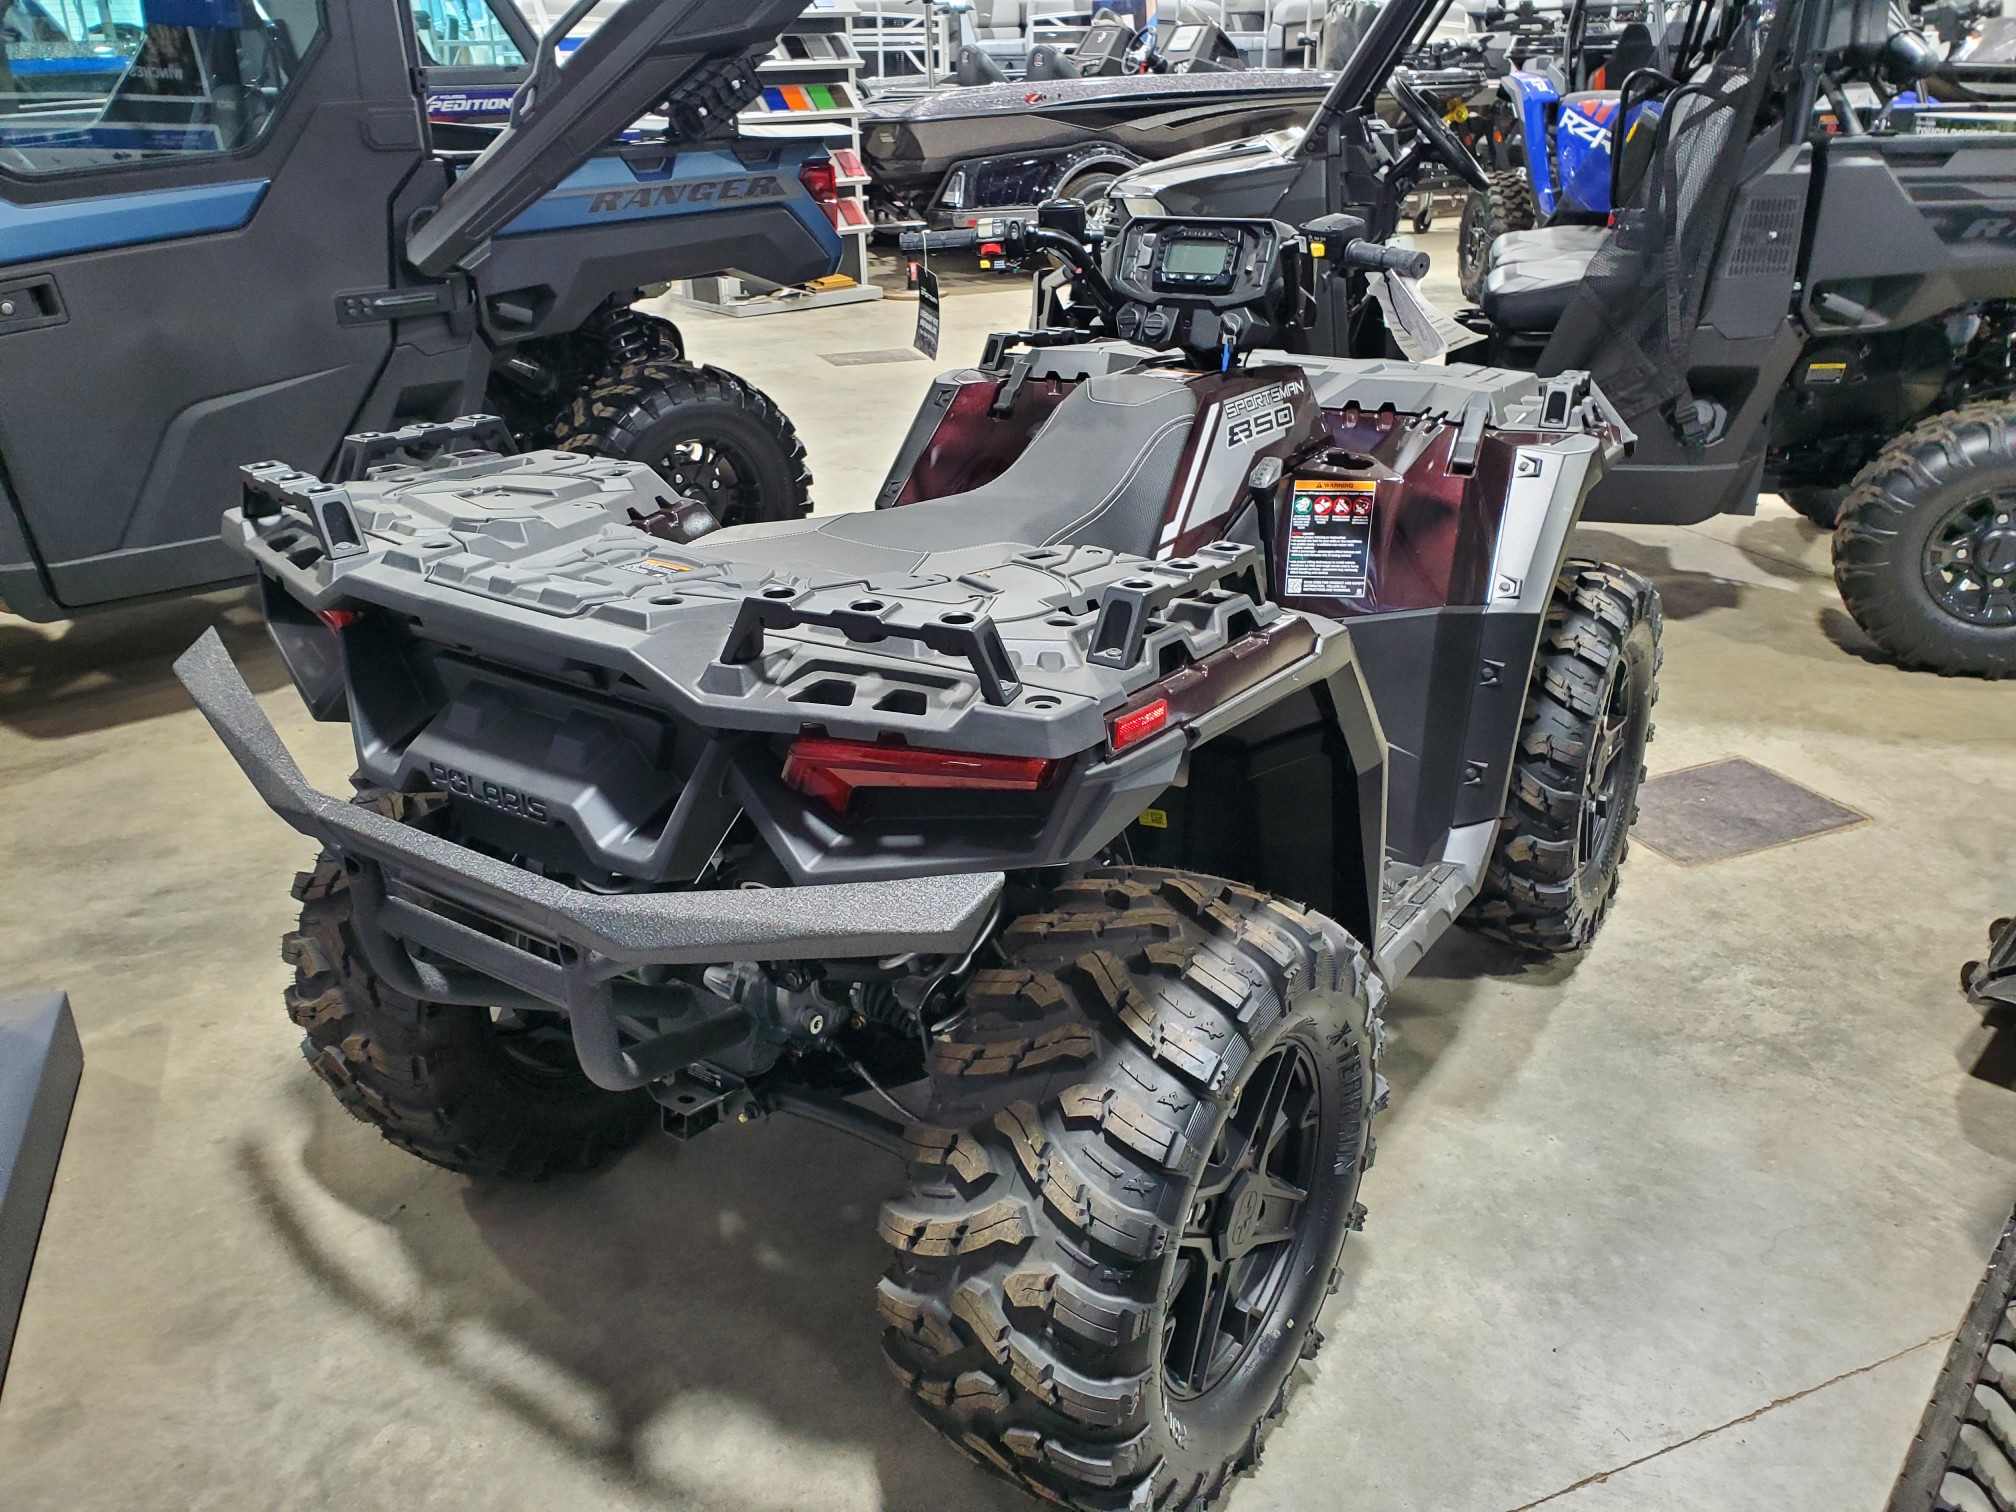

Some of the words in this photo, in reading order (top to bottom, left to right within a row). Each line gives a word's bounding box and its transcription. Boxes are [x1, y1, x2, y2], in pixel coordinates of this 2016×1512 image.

[588, 175, 781, 214] RANGER
[1223, 379, 1305, 420] SPORTSMAN
[1226, 402, 1296, 450] 850
[429, 761, 548, 825] POLARIS
